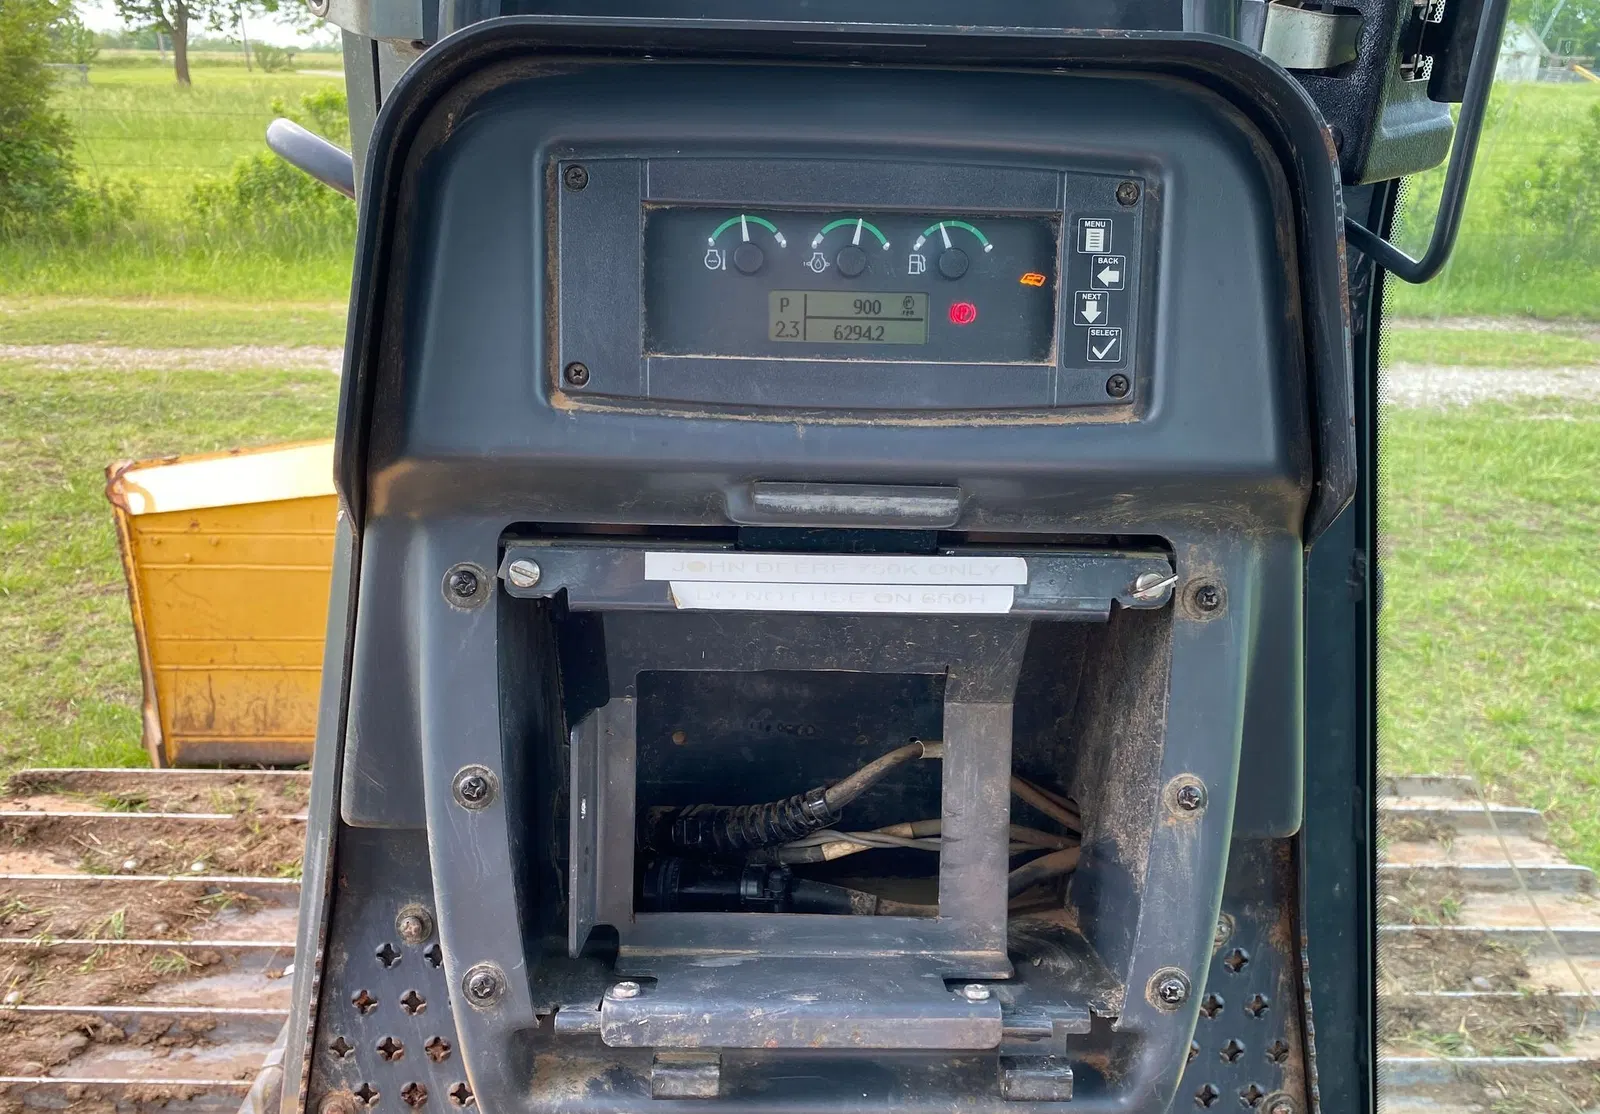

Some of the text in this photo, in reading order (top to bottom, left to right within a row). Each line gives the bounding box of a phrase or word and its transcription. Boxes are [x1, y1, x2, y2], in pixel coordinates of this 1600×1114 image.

[780, 297, 790, 313] P
[853, 299, 882, 315] 900
[775, 321, 800, 338] 2.3
[833, 325, 885, 342] 6294.2
[1091, 329, 1119, 337] SELECT
[672, 560, 745, 574] JOHN
[928, 563, 1001, 577] ONLY
[873, 592, 912, 604] ON
